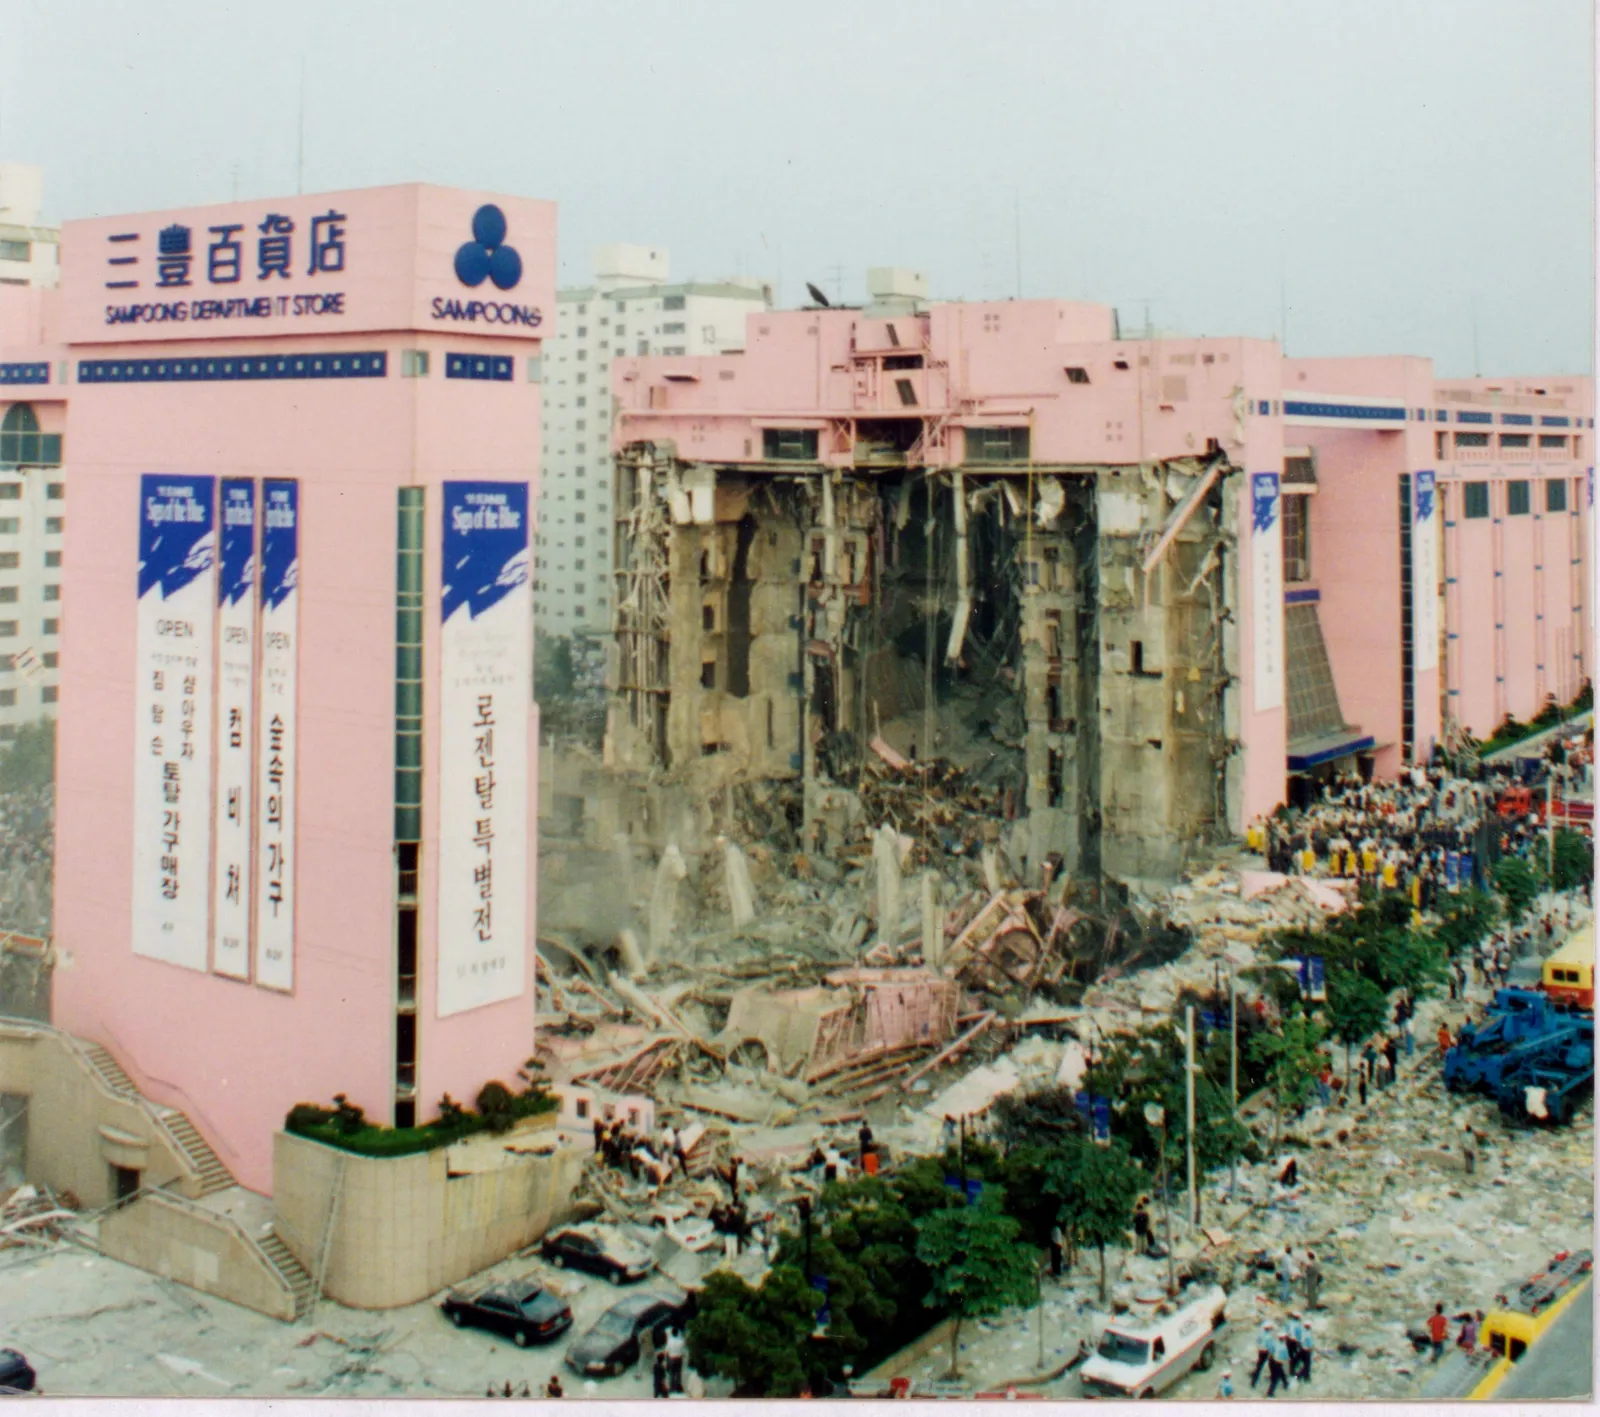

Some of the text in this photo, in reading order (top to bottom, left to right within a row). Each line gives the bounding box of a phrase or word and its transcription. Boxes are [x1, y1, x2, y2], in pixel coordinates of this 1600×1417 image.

[105, 209, 347, 289] 三豐百貨店
[105, 301, 188, 325] SAMPOONG
[293, 292, 346, 316] STORE
[430, 296, 543, 328] SAMPOONG
[156, 619, 194, 638] OPEN
[224, 625, 248, 645] OPEN
[265, 631, 291, 650] OPEN
[473, 694, 497, 811] 로젠탈
[267, 841, 284, 918] 가구
[471, 816, 496, 943] 특별전
